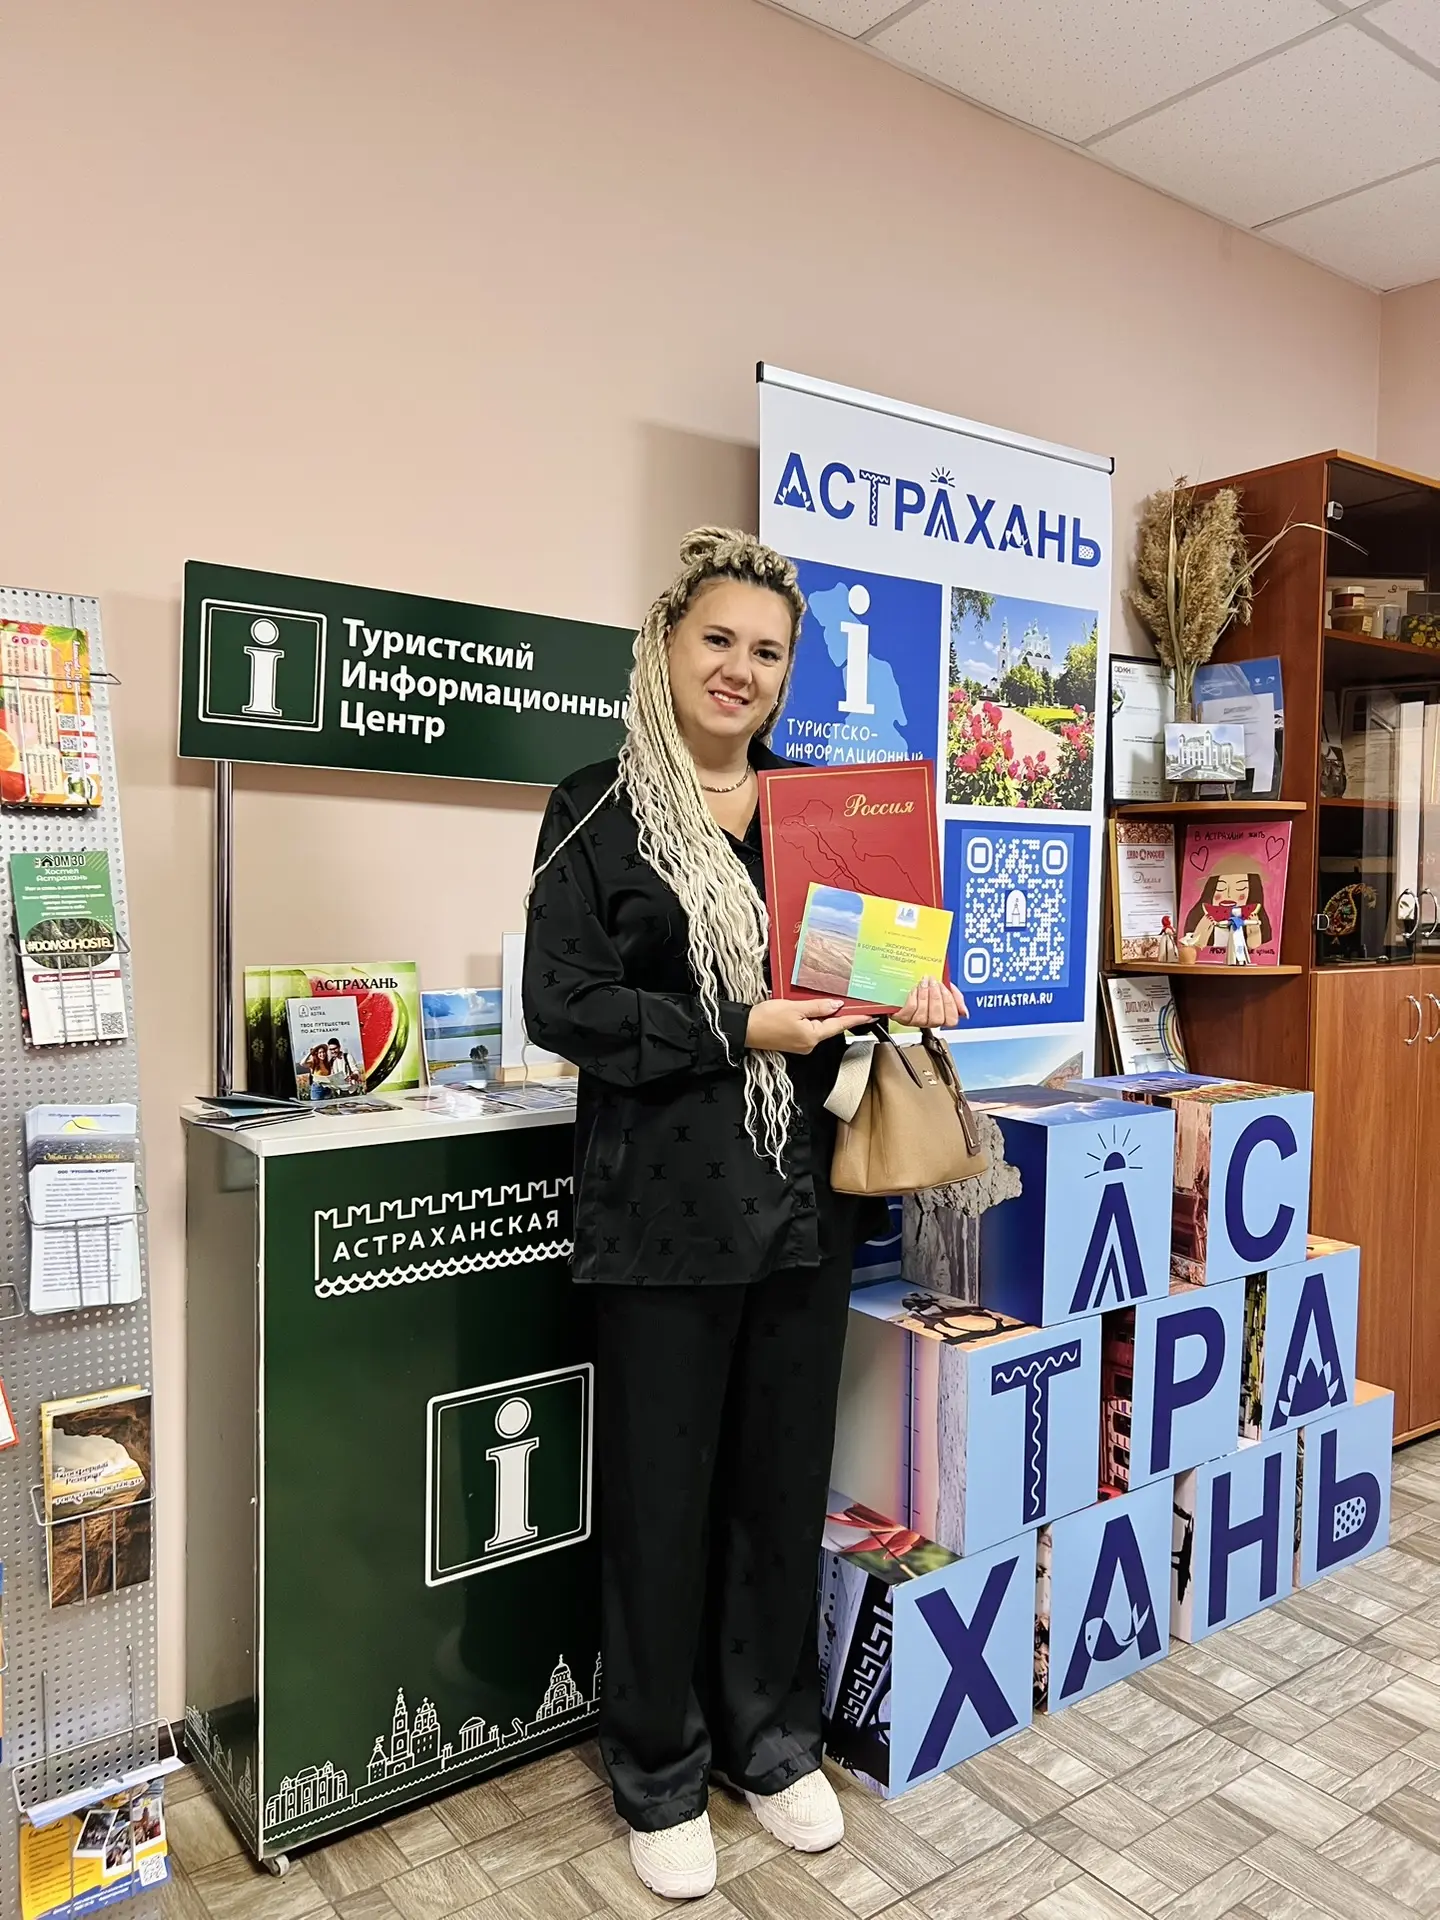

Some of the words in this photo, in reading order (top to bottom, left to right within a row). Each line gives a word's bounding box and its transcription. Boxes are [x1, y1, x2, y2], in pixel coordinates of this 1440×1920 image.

[773, 452, 1102, 568] АСТРАХАНЬ
[341, 617, 535, 671] Туристский
[340, 701, 446, 744] Центр
[786, 718, 878, 742] ТУРИСТСКО-
[844, 793, 915, 817] Россия
[315, 977, 399, 992] АСТРАХАНЬ
[976, 992, 1053, 1008] VIZITASTRA.RU
[332, 1209, 559, 1263] АСТРАХАНСКАЯ
